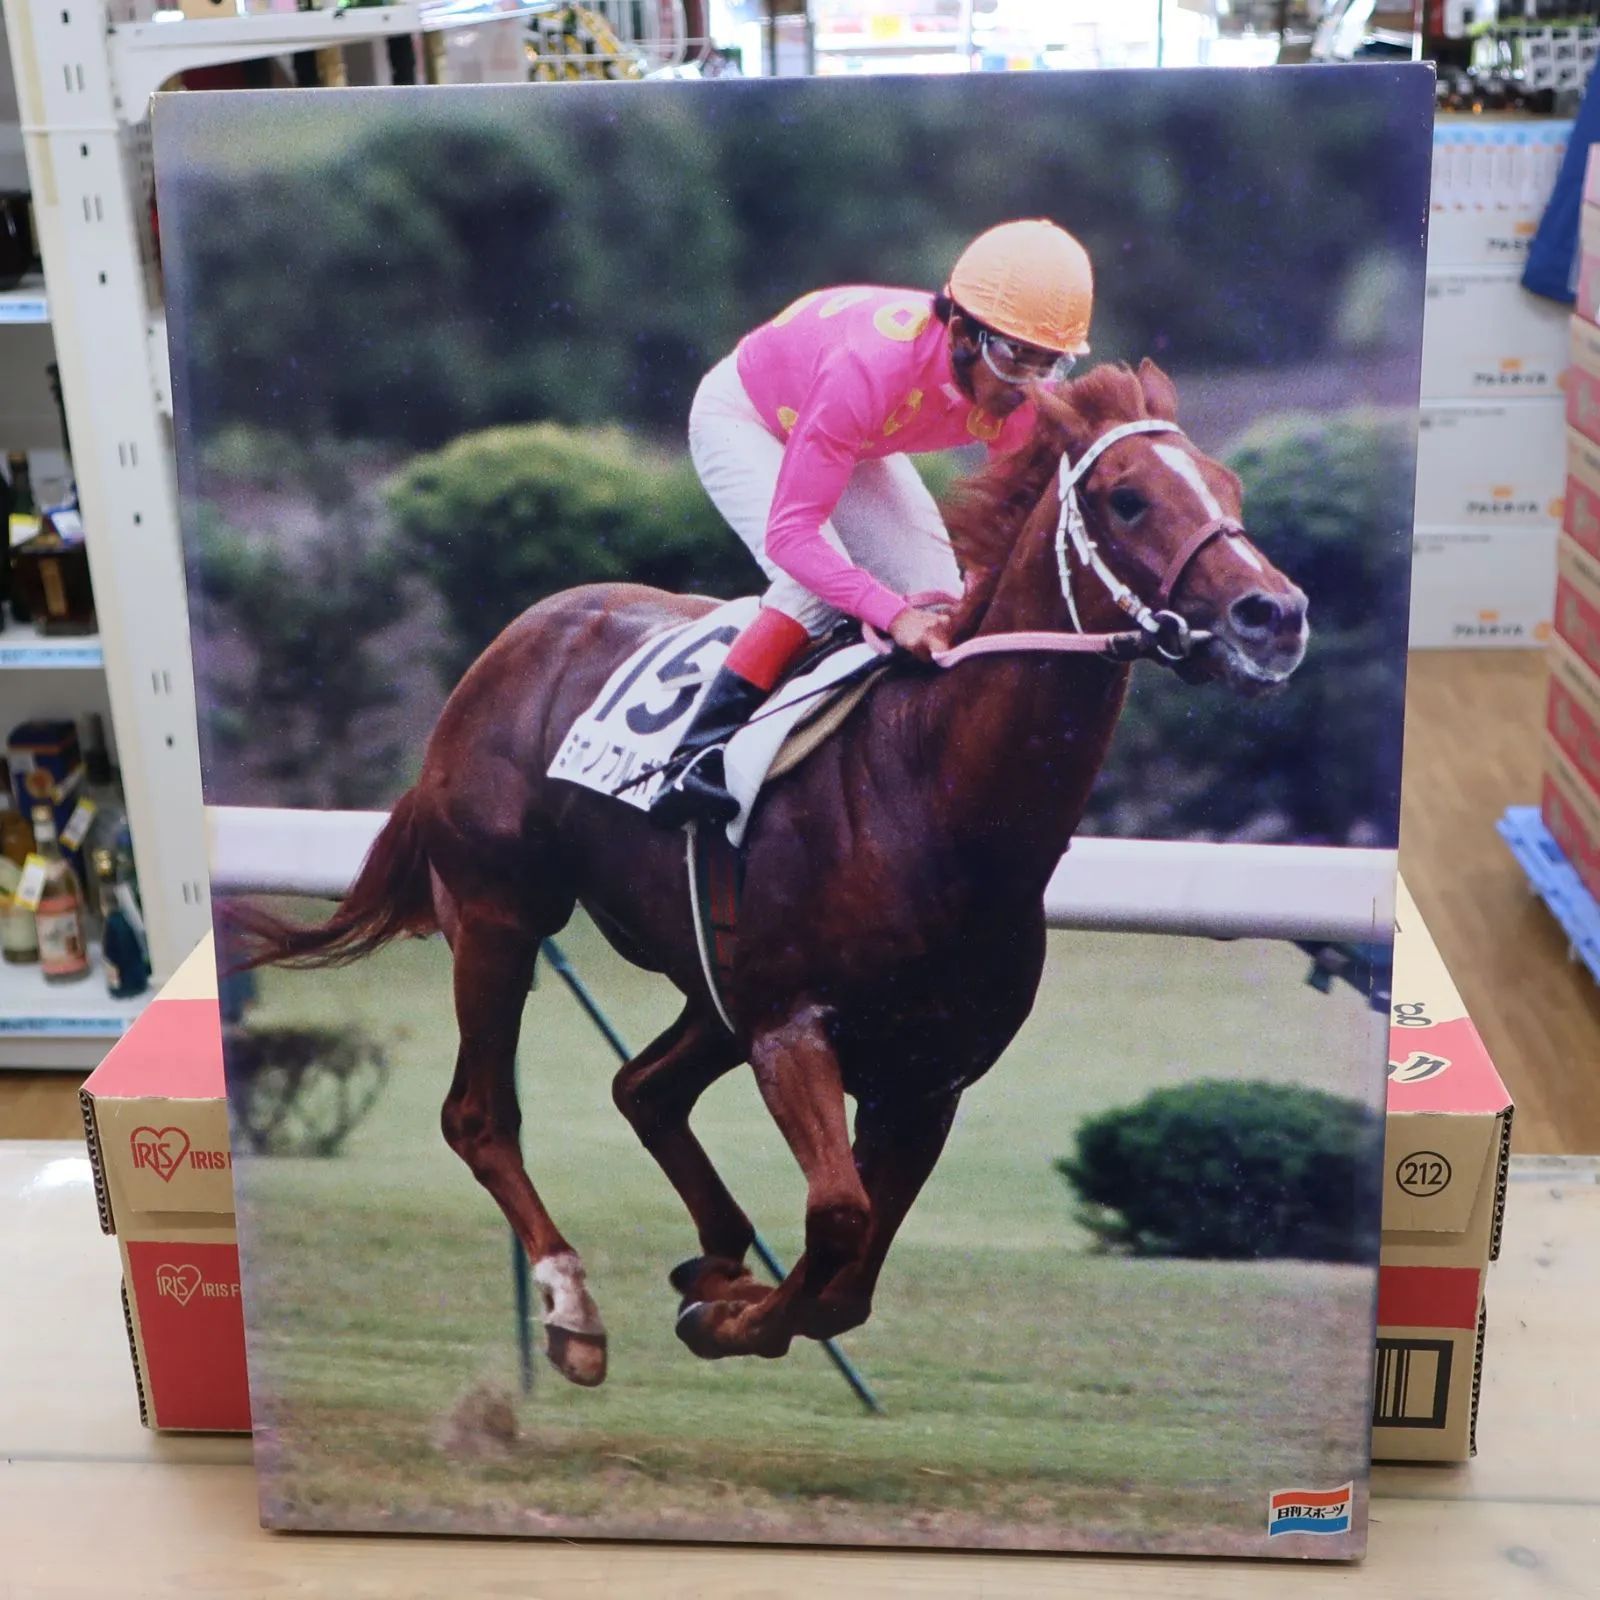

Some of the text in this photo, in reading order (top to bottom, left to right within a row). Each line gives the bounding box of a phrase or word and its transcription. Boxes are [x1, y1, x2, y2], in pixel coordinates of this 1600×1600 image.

[594, 625, 739, 735] 15
[131, 1142, 171, 1169] IRIS
[190, 1151, 225, 1169] IRIS
[1403, 1162, 1442, 1185] 212
[157, 1276, 188, 1296] IRIS
[201, 1282, 229, 1297] IRIS
[1277, 1504, 1345, 1520] 日刊スポーツ
